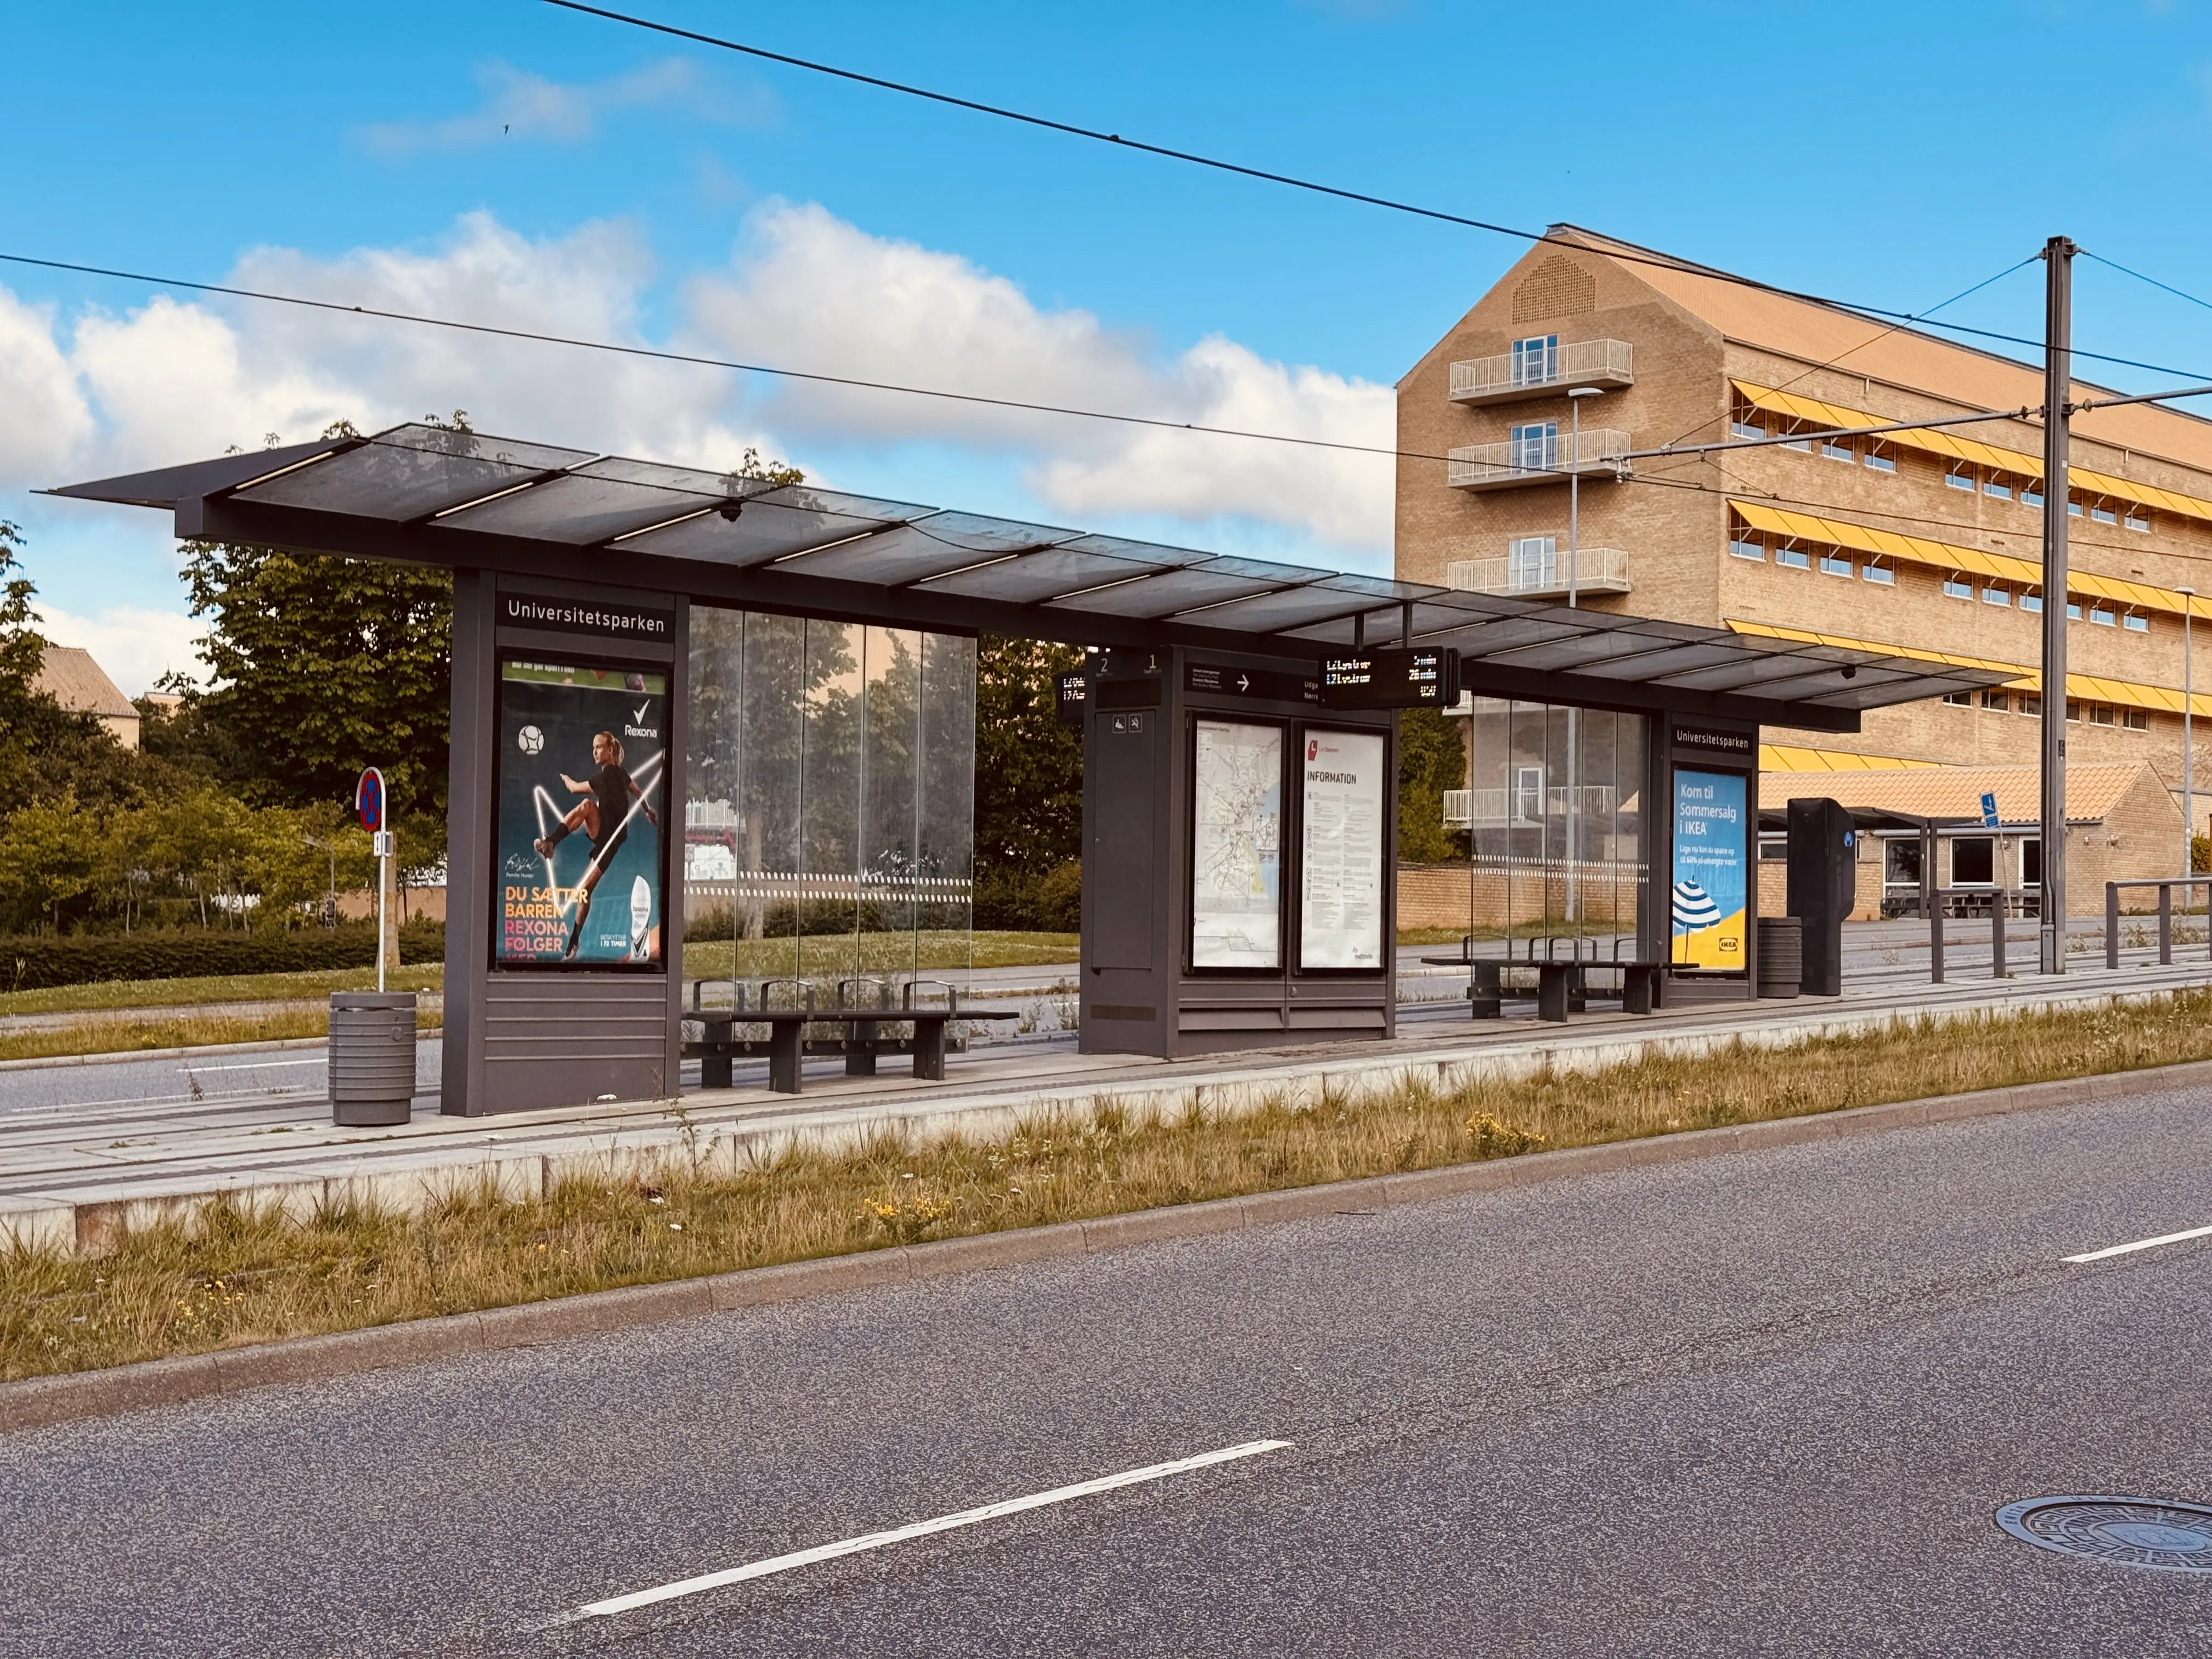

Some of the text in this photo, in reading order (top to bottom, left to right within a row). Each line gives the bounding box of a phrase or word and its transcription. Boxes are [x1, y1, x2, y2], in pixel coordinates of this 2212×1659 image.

[509, 600, 664, 632] Universitetsparken
[1101, 658, 1108, 672] 2
[1150, 654, 1156, 669] 1
[1304, 681, 1318, 690] Udga
[625, 724, 657, 738] Rexona
[1677, 730, 1748, 749] Universitetsparken
[1307, 771, 1356, 785] INFORMATION
[1681, 783, 1713, 799] Kom til
[1680, 802, 1736, 823] Sommersalg
[1679, 820, 1707, 836] i IKEA
[505, 886, 588, 904] DU SÆTTER
[505, 903, 564, 919] BARREN
[505, 920, 569, 936] REXONA
[505, 936, 563, 952] FØLGER
